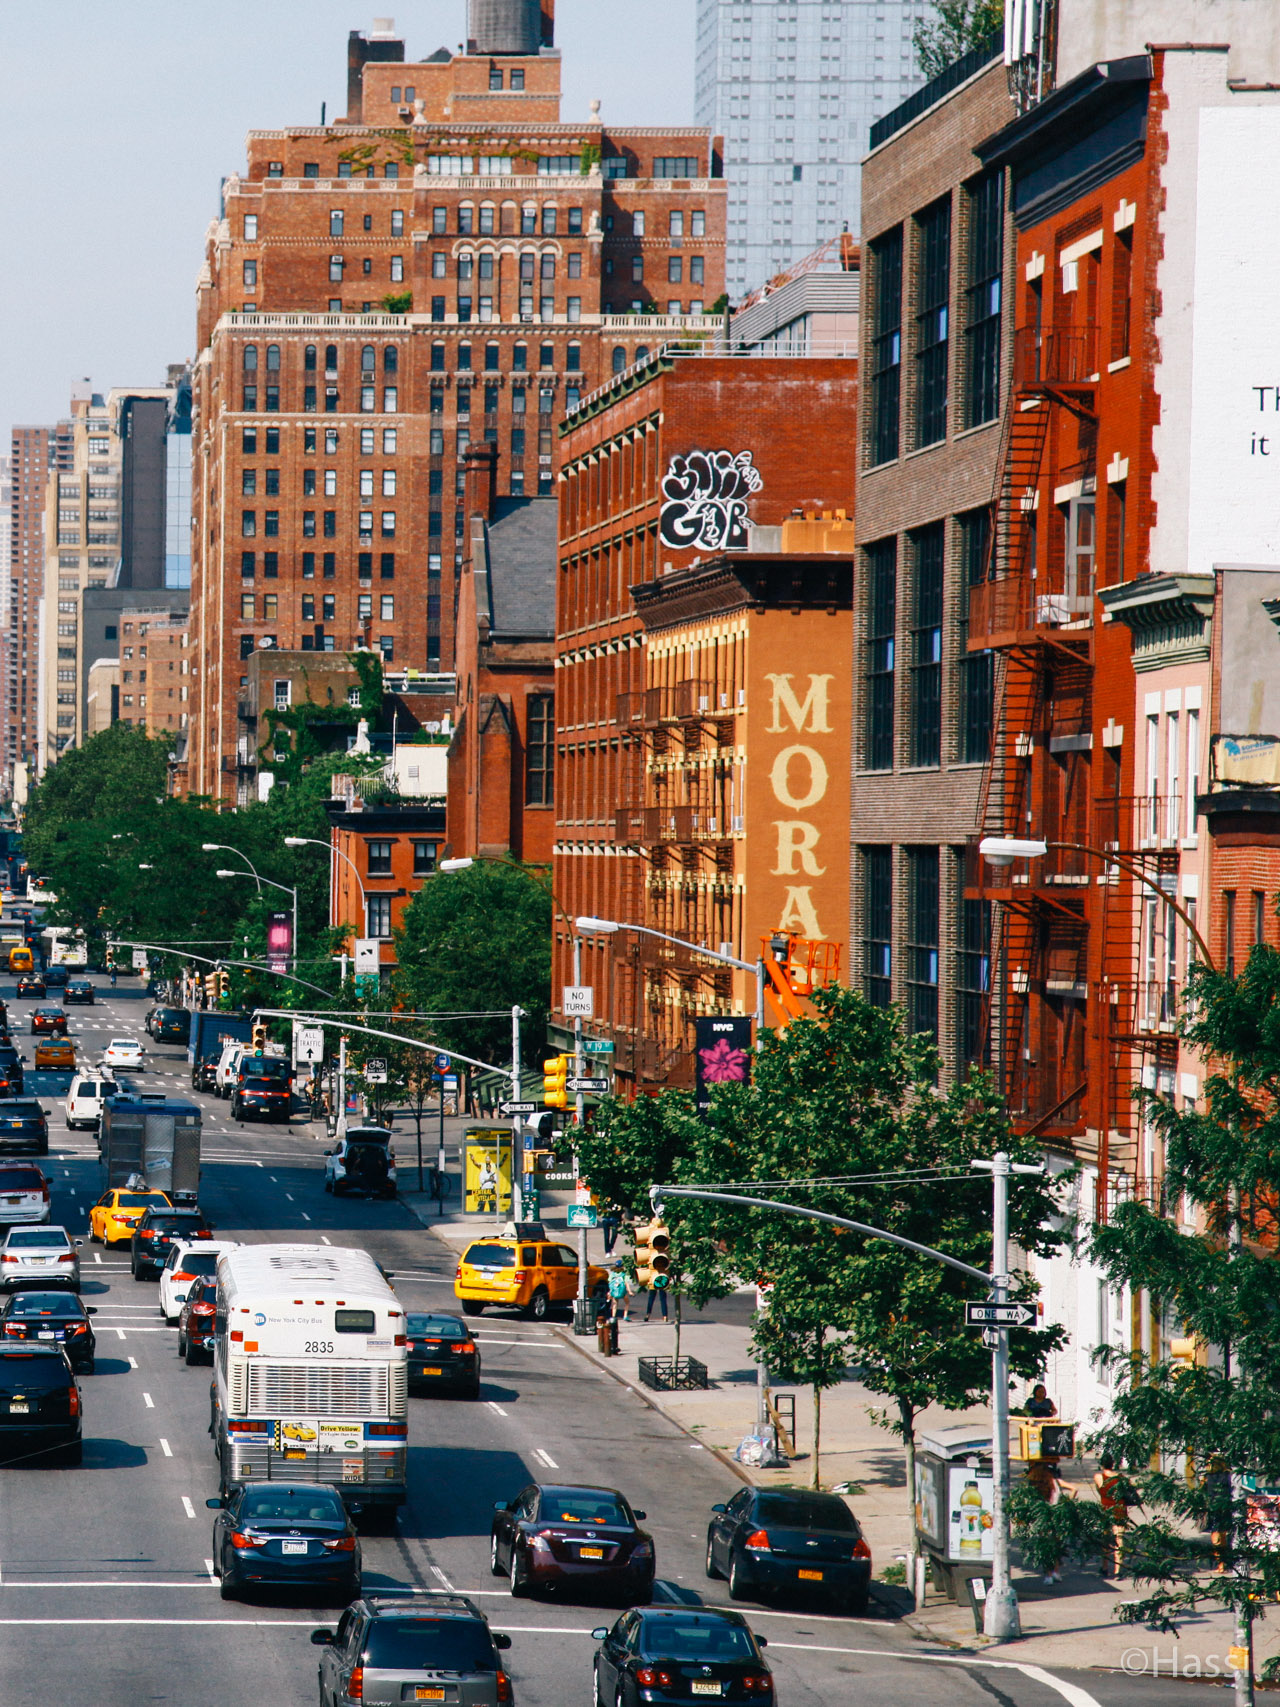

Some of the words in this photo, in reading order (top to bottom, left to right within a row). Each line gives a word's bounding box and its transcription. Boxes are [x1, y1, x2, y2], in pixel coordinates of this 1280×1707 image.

[1251, 432, 1270, 455] it
[571, 992, 585, 1000] NO
[565, 1003, 591, 1011] TURNS
[713, 1023, 734, 1031] NYC
[595, 1042, 602, 1050] 19
[977, 1309, 996, 1319] ONE
[1006, 1310, 1026, 1319] WAY
[297, 1317, 308, 1325] City
[304, 1341, 334, 1353] 2835
